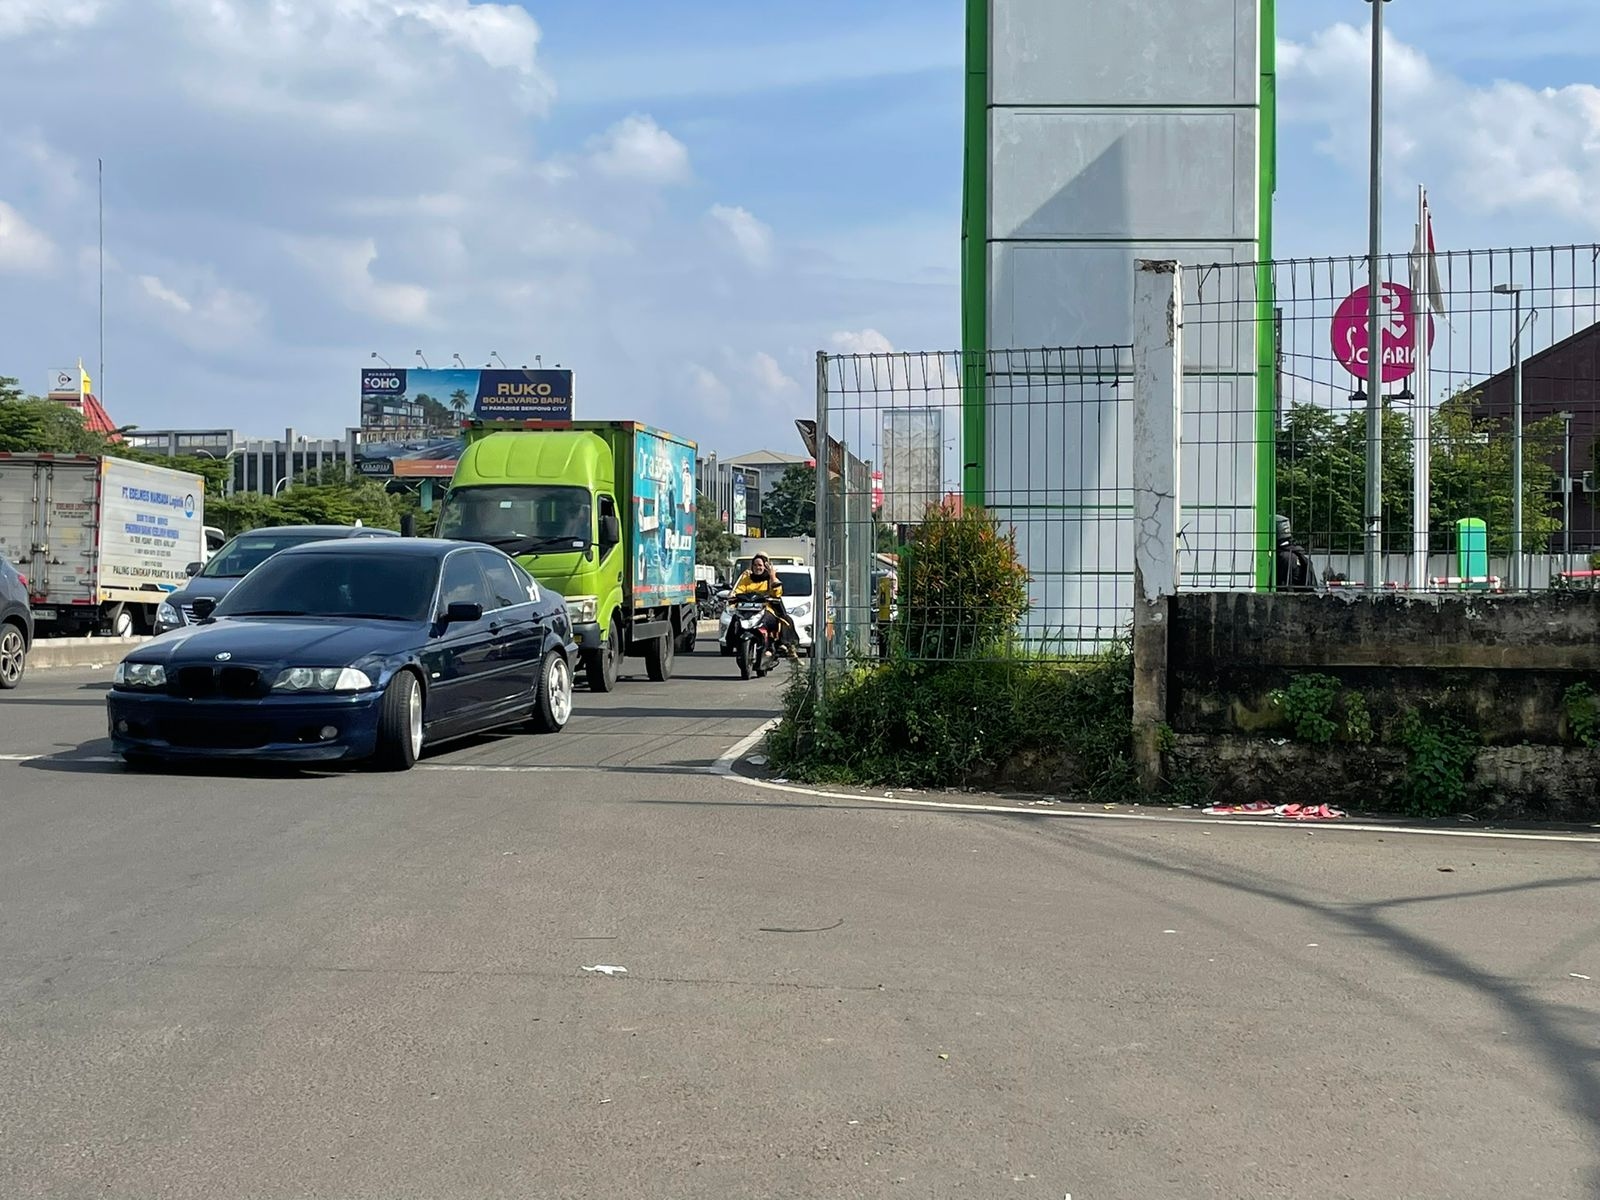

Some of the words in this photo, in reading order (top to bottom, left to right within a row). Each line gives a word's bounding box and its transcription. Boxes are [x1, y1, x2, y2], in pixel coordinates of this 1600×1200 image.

[363, 377, 400, 389] SOHO
[497, 383, 552, 396] RUKO
[113, 565, 129, 576] PALING
[130, 566, 150, 577] LENGKAP
